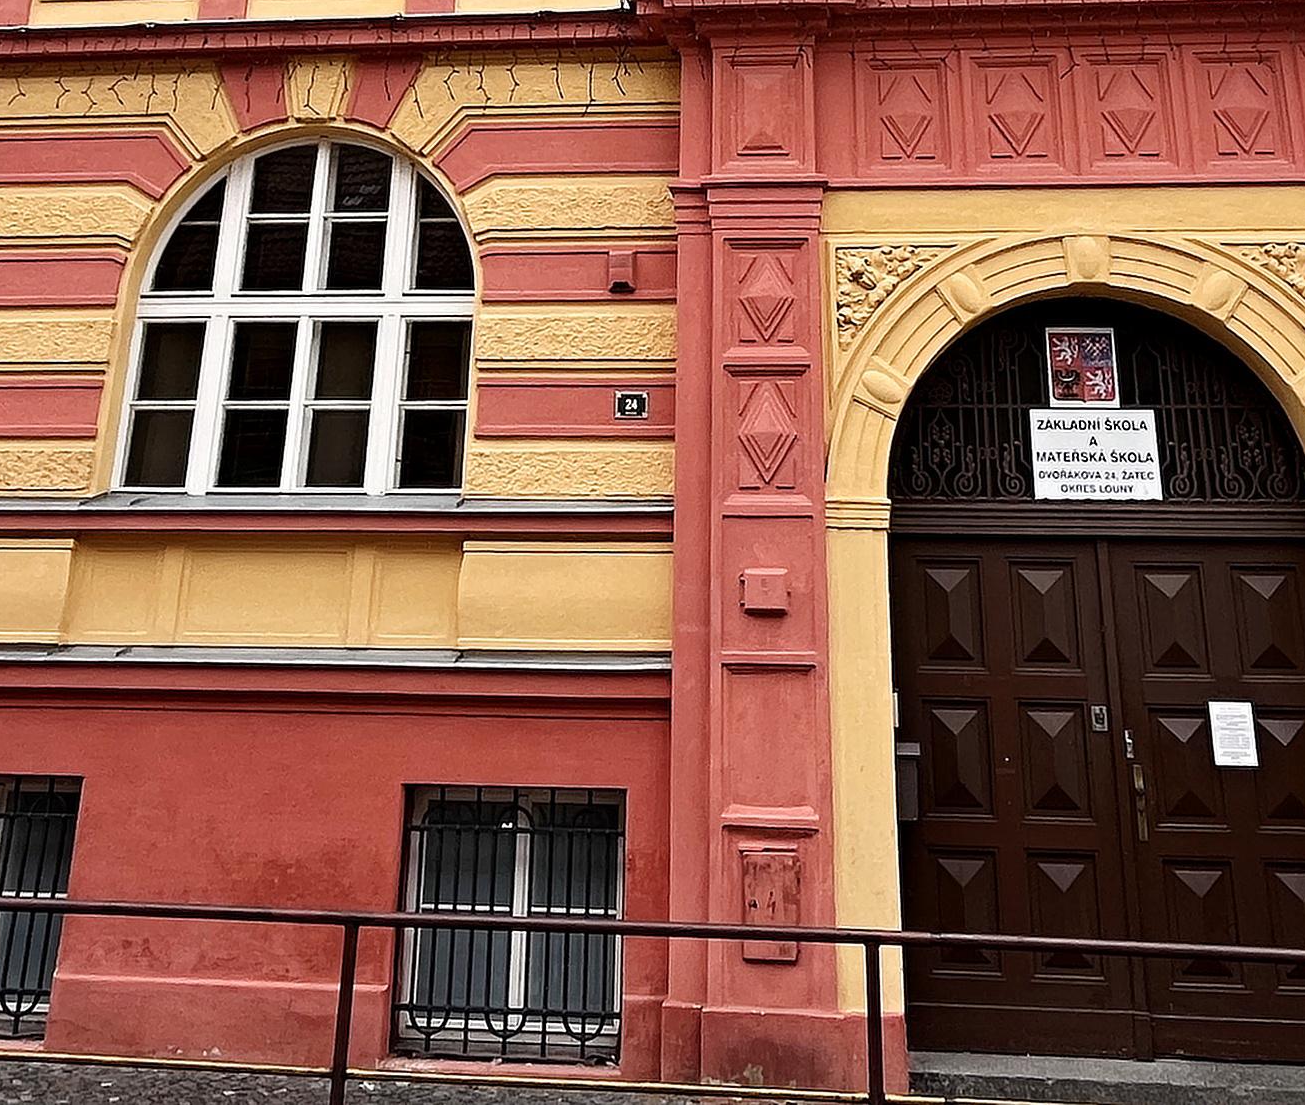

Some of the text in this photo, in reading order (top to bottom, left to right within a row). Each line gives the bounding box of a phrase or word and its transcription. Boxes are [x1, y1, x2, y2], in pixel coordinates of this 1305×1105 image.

[625, 398, 638, 410] 24
[1036, 416, 1148, 431] ZÁKLADNÍ ŠKOLA
[1089, 436, 1098, 446] A
[1036, 449, 1154, 463] MATEŘSKÁ ŠKOLA
[1060, 484, 1134, 494] OKRES LOUNY
